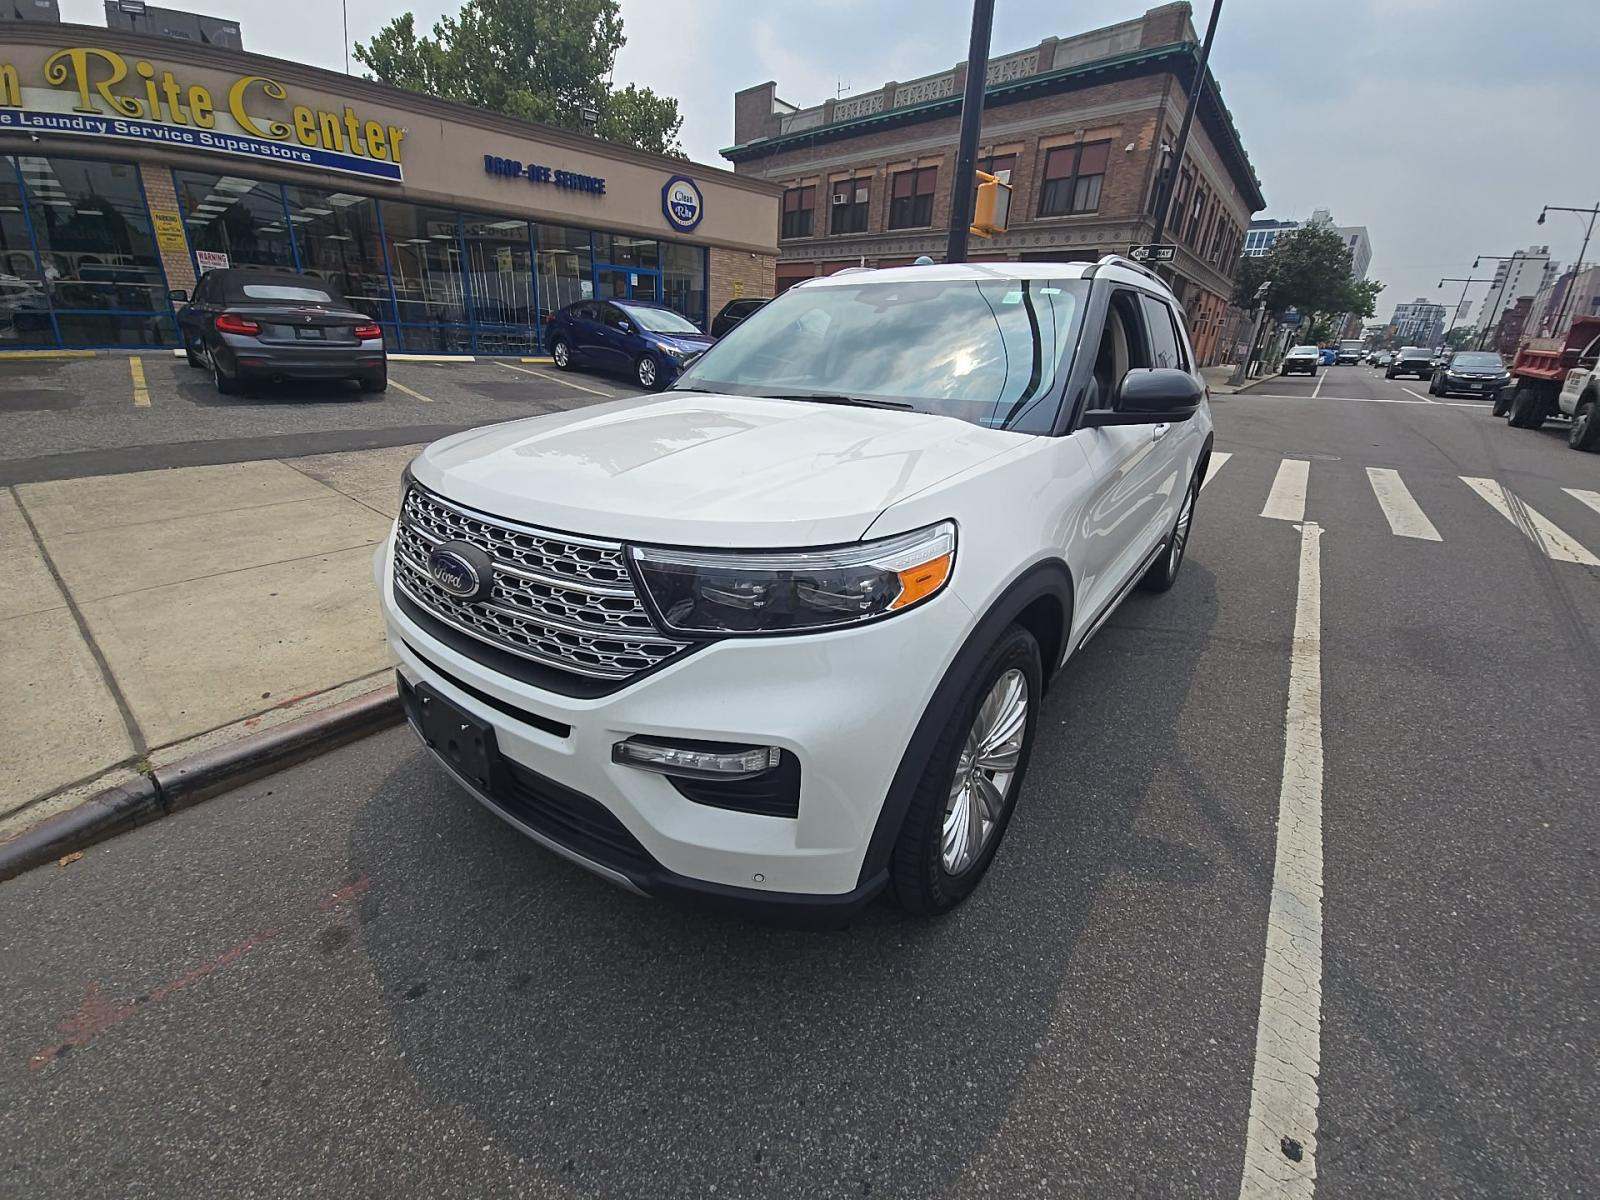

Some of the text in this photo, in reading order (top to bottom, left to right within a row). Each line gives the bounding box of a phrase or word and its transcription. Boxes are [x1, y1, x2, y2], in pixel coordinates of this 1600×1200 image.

[44, 47, 215, 129] Rite
[228, 75, 405, 163] Center
[20, 112, 107, 134] Laundry
[114, 121, 194, 142] Service
[199, 133, 311, 162] Superstore
[483, 154, 607, 195] DROP-OFF SERVICE
[198, 251, 227, 262] WARNING
[433, 558, 464, 589] Ford
